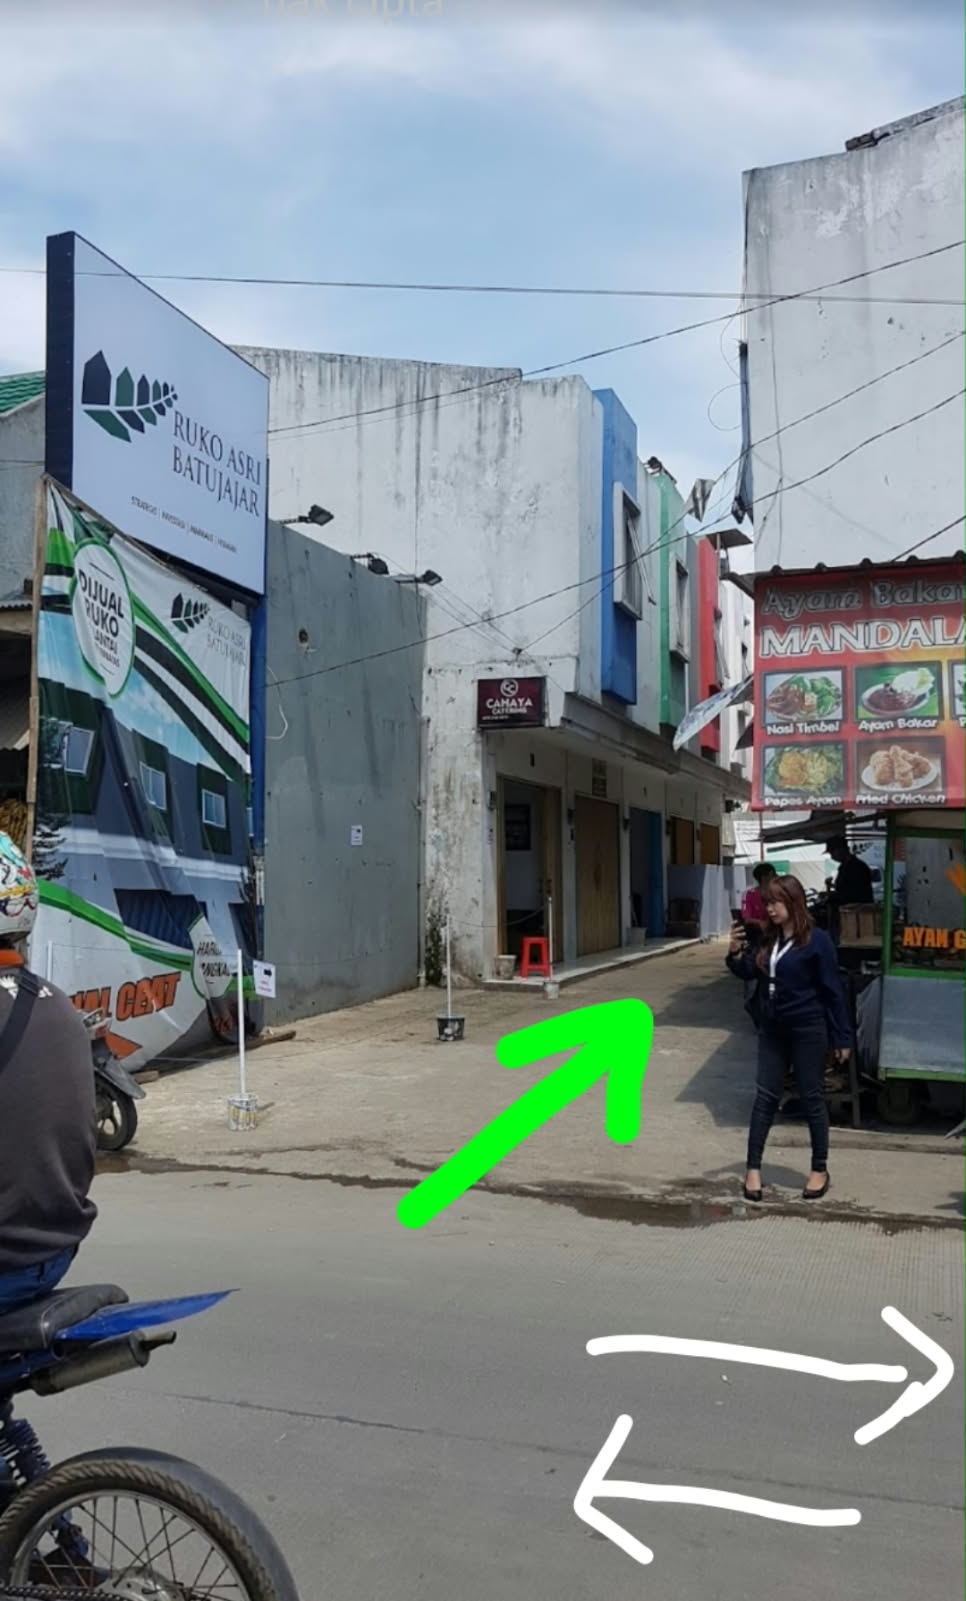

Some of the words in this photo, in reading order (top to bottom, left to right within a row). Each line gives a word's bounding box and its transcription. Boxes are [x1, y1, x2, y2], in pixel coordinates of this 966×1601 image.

[174, 410, 223, 462] RUKO
[227, 446, 260, 486] ASRI
[173, 444, 259, 517] BATUJAJAR
[79, 568, 124, 619] DIJUAL
[763, 586, 862, 619] Ayam
[85, 598, 119, 637] RUKO
[486, 698, 532, 708] CAHAYA
[767, 723, 794, 735] Nasi
[798, 720, 840, 734] Timbel
[858, 720, 893, 733] Ayam
[897, 718, 938, 729] Bakar
[856, 793, 888, 805] Fried
[892, 793, 946, 804] Chicken
